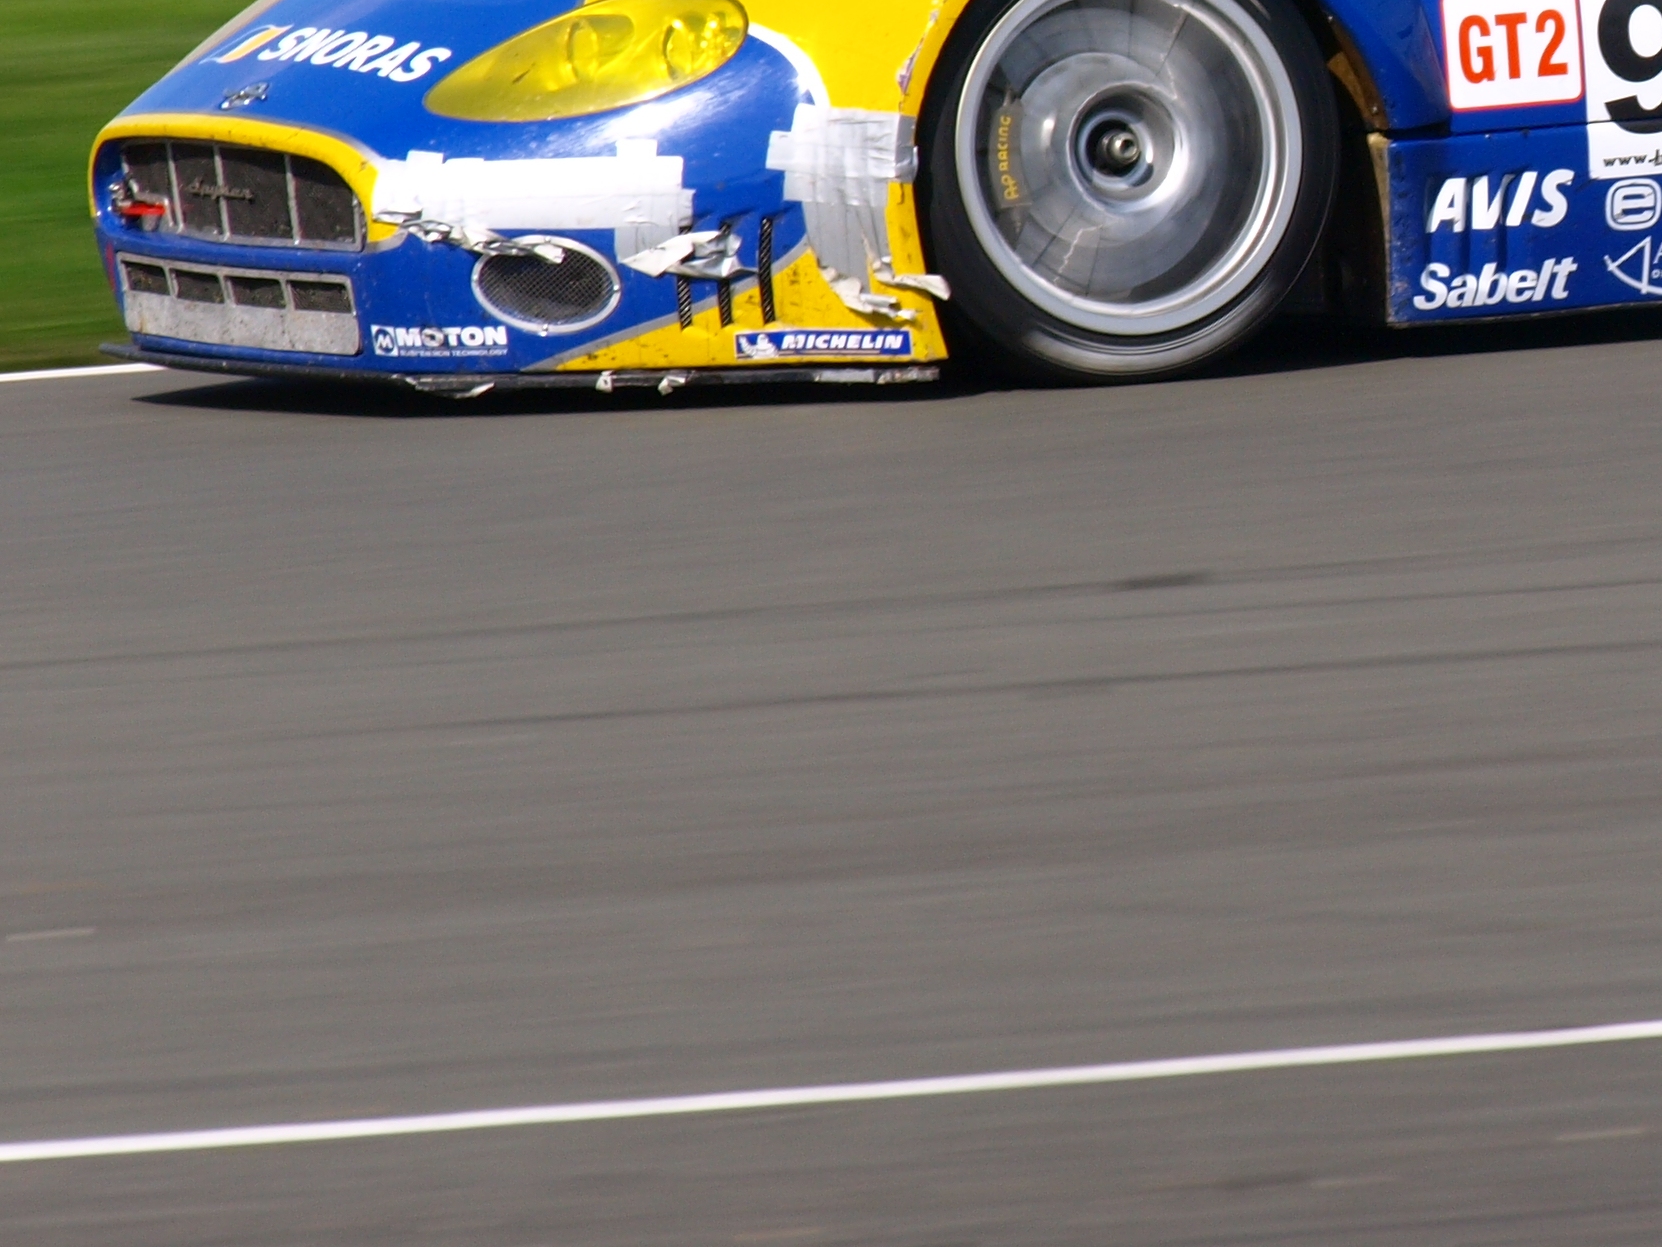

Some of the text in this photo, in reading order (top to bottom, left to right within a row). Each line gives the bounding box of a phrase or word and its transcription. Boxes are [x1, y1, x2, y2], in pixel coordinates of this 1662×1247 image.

[257, 27, 452, 82] SNORAS
[1458, 8, 1569, 84] GT2
[1425, 168, 1576, 234] AVIS
[1413, 256, 1579, 311] Sabelt
[395, 325, 508, 347] MOTON
[780, 334, 904, 350] MICHELIN
